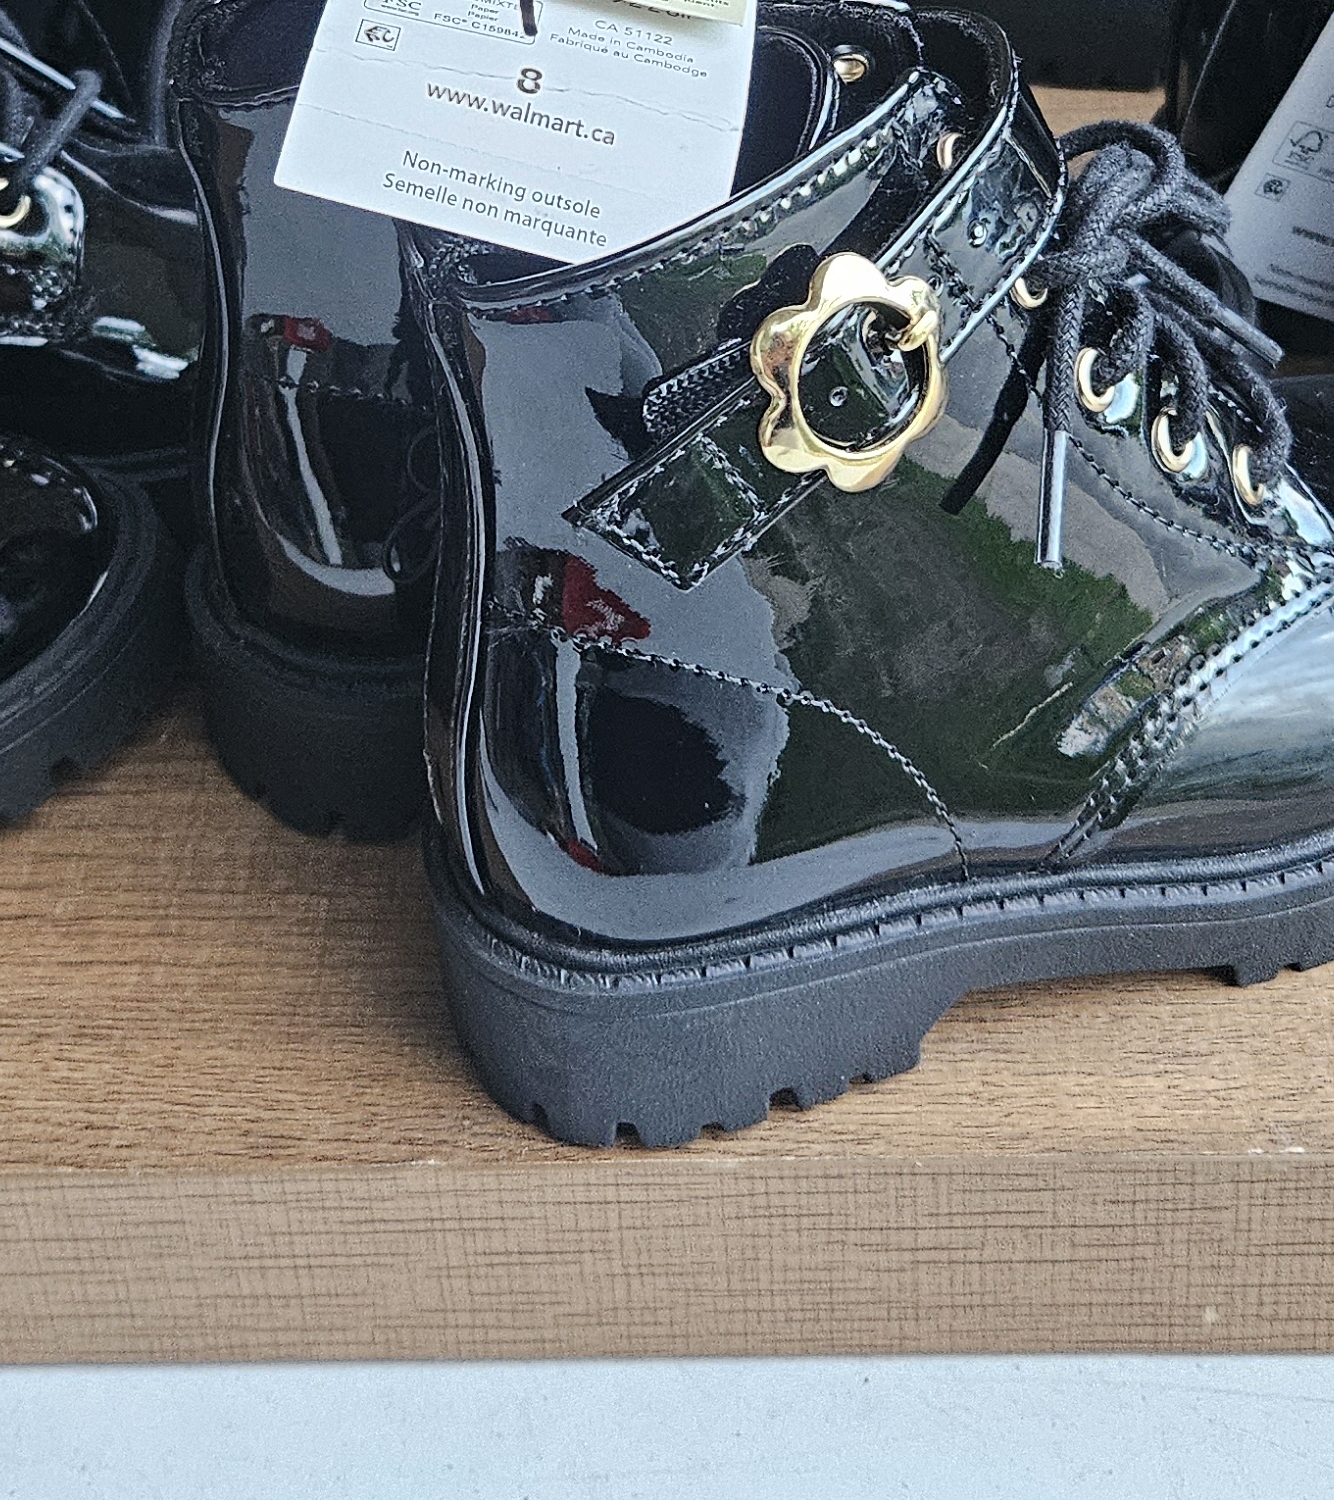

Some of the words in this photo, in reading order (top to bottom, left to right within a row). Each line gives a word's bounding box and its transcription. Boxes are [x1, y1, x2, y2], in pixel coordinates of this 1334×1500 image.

[467, 11, 499, 22] Papier
[470, 3, 500, 15] Paper
[568, 26, 605, 42] Made
[610, 36, 621, 47] in
[626, 41, 694, 63] Cambodia
[594, 19, 618, 33] CA
[624, 27, 673, 46] 51122
[549, 33, 609, 54] Fabriqué
[613, 50, 629, 60] au
[633, 53, 708, 77] Cambodge
[517, 68, 543, 94] 8
[427, 82, 615, 145] www.walmart.ca
[402, 150, 527, 202] Non-marking
[531, 190, 601, 218] outsole
[382, 173, 458, 206] Semelle
[461, 197, 499, 218] non
[503, 208, 608, 247] marquante
